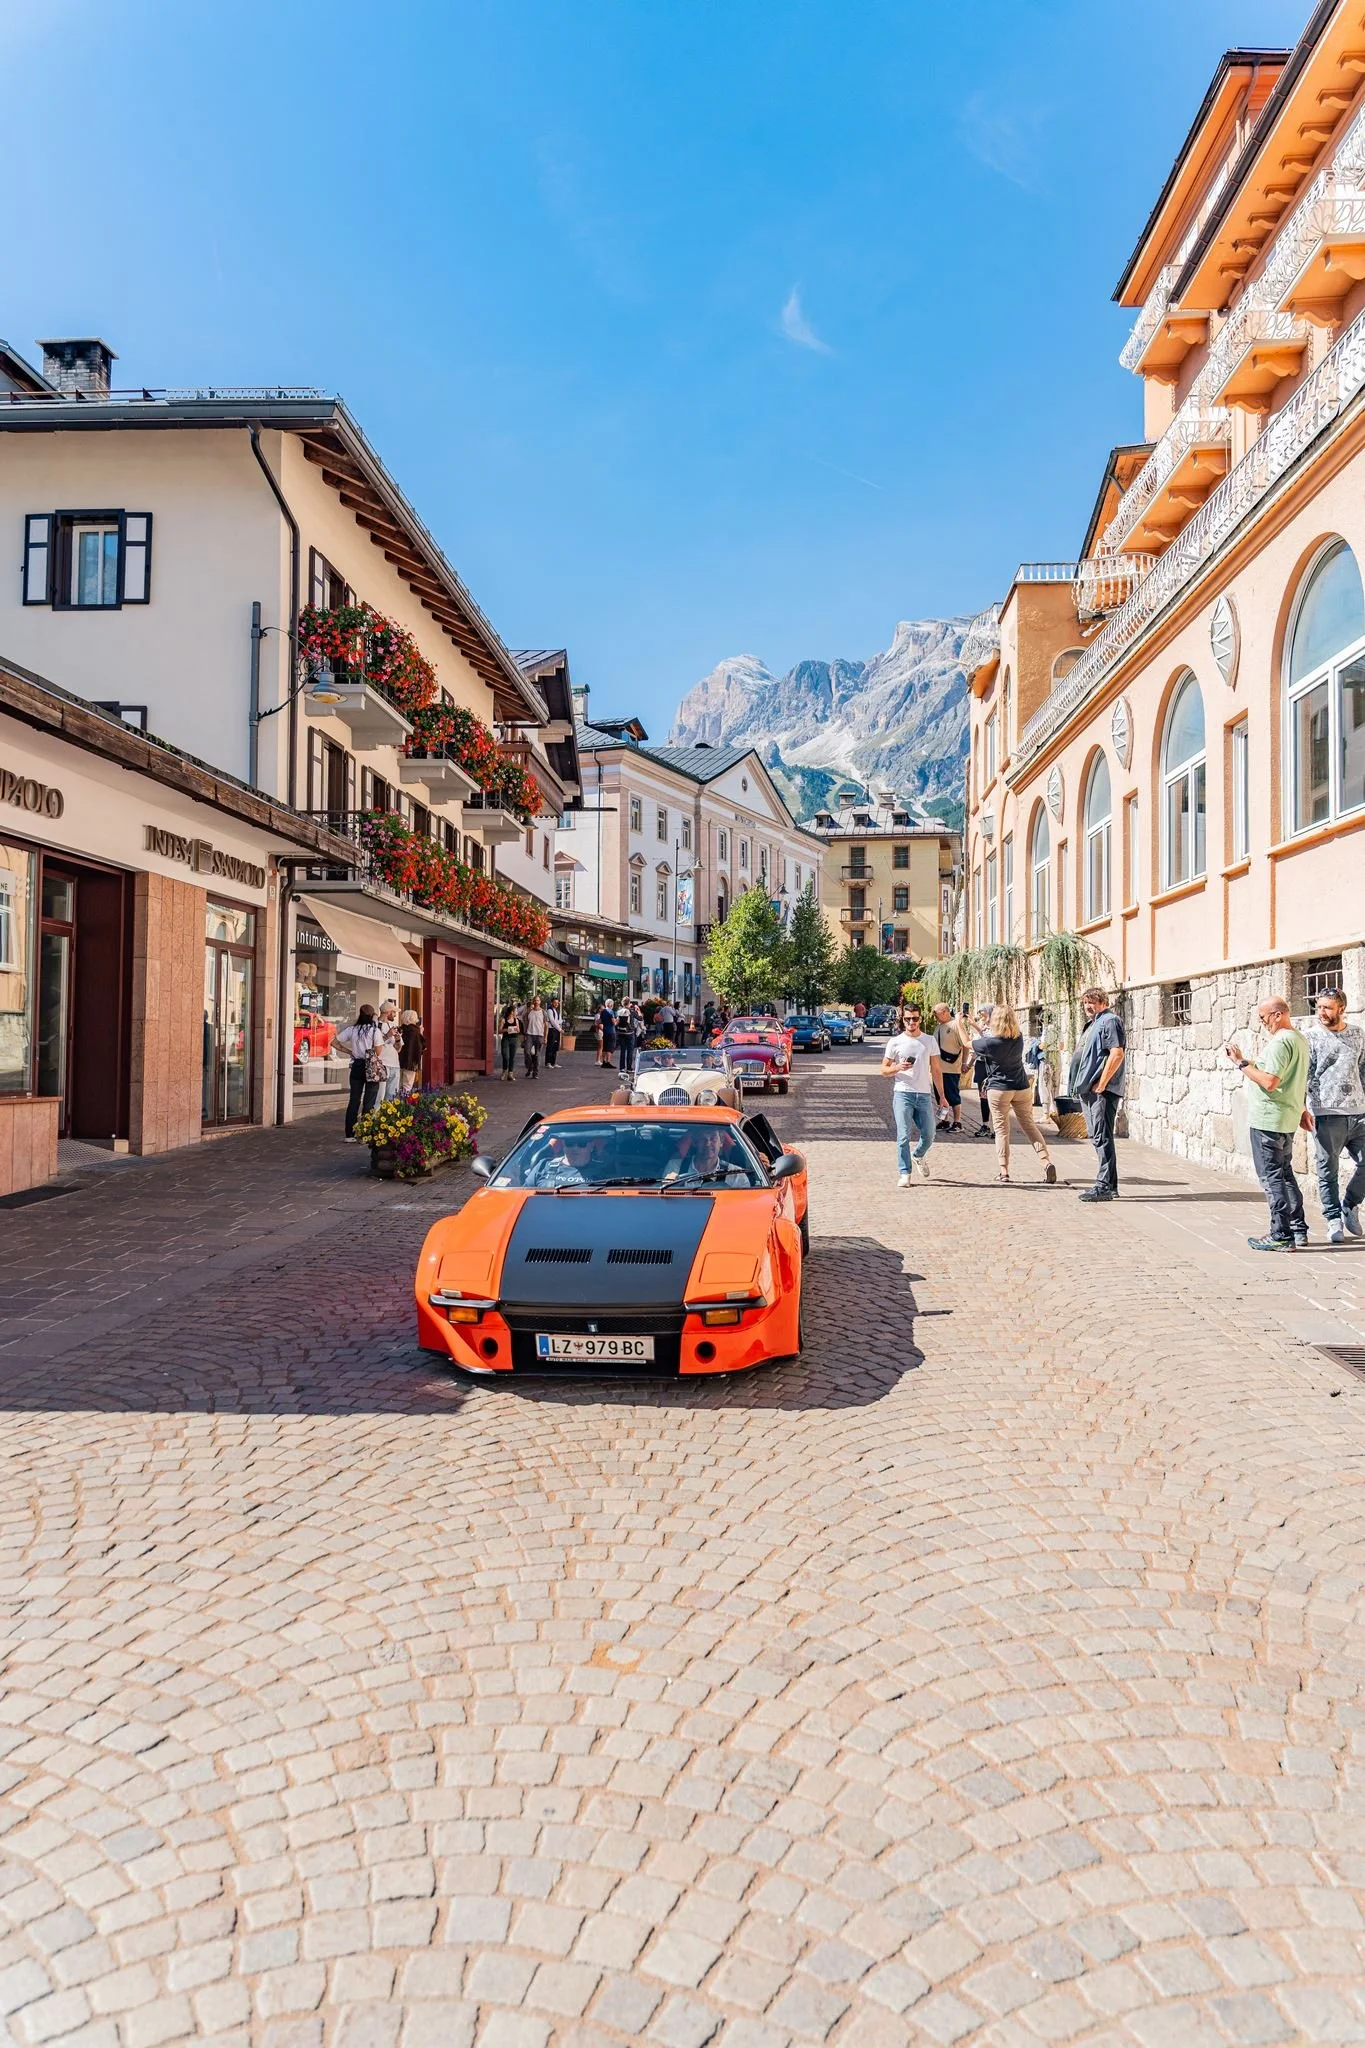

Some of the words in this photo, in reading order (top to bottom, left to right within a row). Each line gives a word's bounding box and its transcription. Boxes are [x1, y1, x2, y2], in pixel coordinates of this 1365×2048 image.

[0, 767, 64, 819] PAOLO
[211, 850, 266, 889] SANPAOLO
[296, 930, 337, 951] intimissi
[365, 963, 401, 981] intimissimi
[551, 1338, 572, 1354] LZ
[585, 1340, 618, 1355] 979
[623, 1340, 644, 1355] BC
